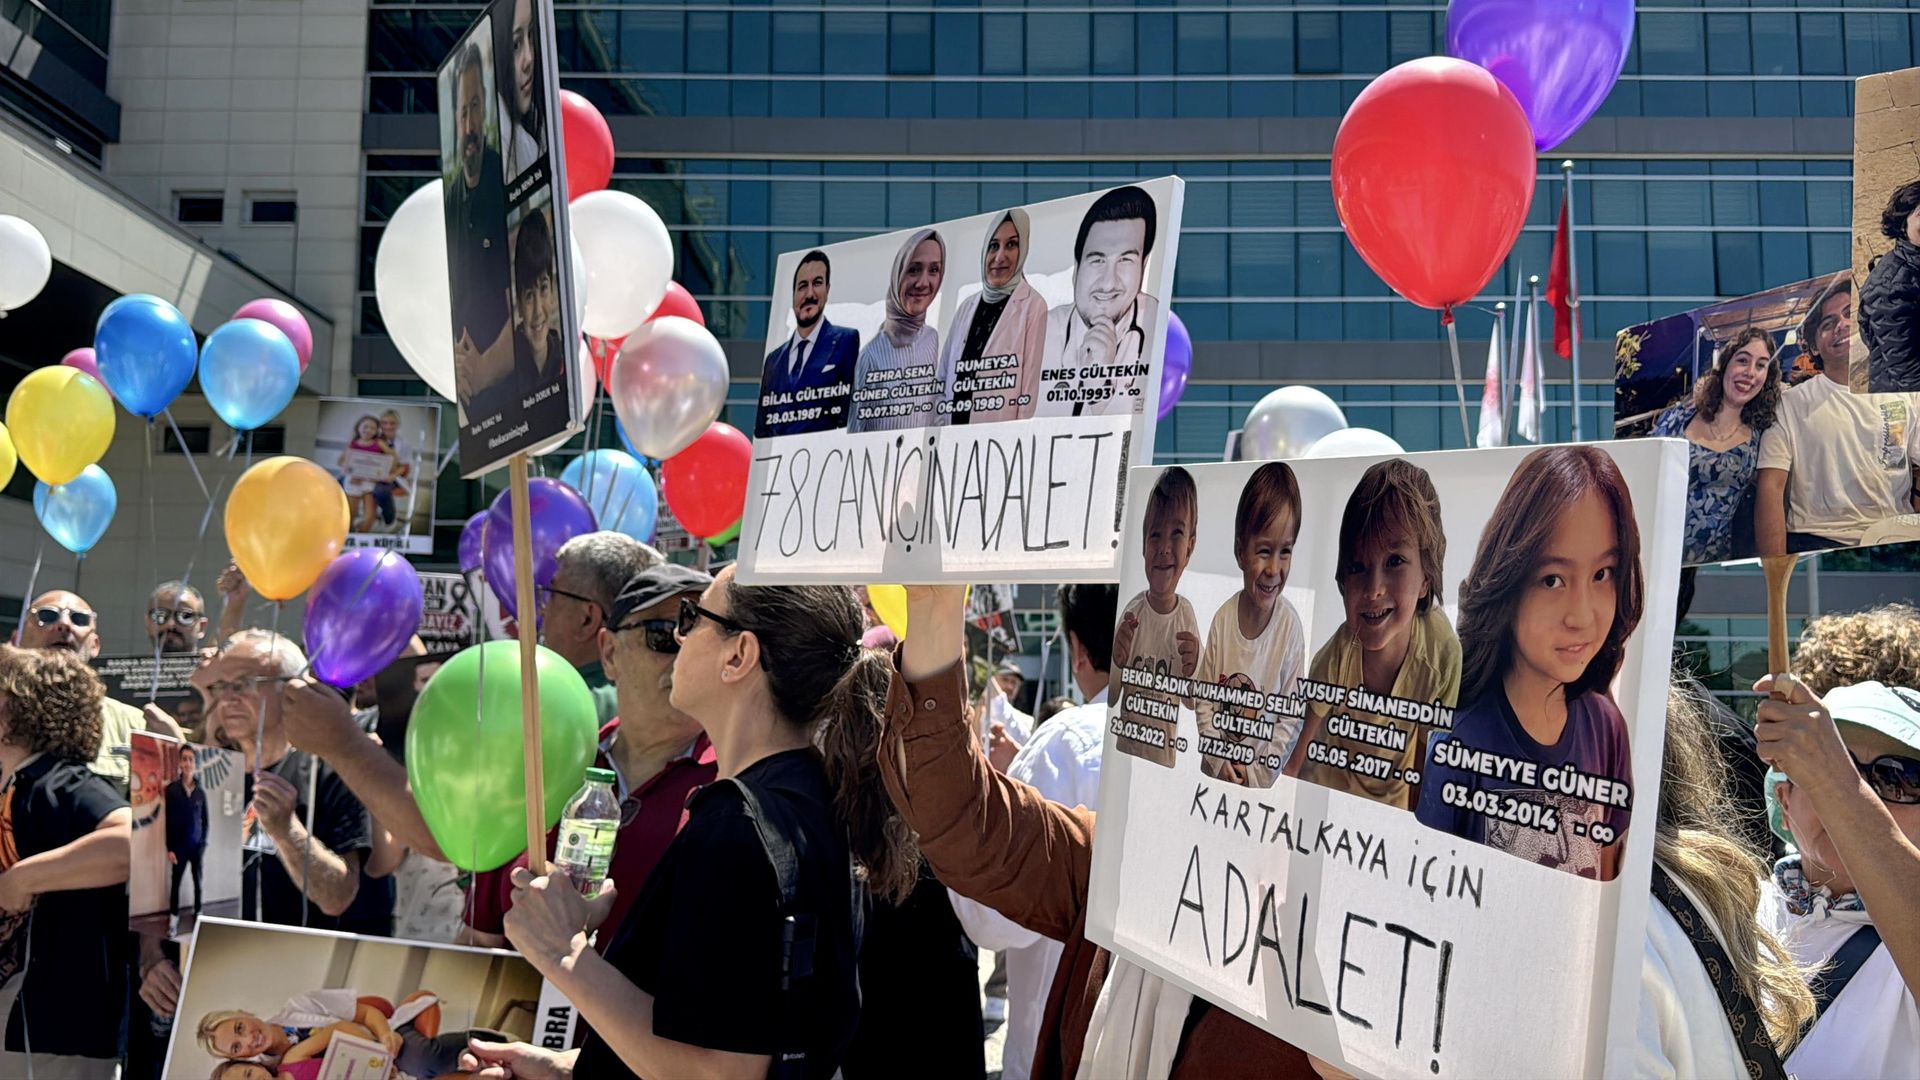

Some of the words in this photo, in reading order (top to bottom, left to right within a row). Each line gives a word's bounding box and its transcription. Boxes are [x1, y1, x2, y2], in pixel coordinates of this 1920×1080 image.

[866, 370, 902, 384] ZEHRA
[904, 366, 934, 379] SENA
[955, 354, 1018, 373] RUMEYSA
[1041, 368, 1076, 381] ENES
[1079, 361, 1149, 380] GÜLTEKİN
[762, 391, 793, 407] BİLAL
[796, 381, 850, 403] GÜLTEKİN
[853, 387, 888, 402] GÜNER
[891, 379, 945, 398] GÜLTEKİN
[953, 371, 1016, 393] GÜLTEKİN
[1047, 388, 1111, 402] 01.10.1993
[766, 407, 822, 425] 28.03.1987
[858, 403, 913, 419] 30.07.1987
[1121, 667, 1153, 688] BEKİR
[1154, 674, 1190, 697] SADIK
[1125, 694, 1178, 721] GÜLTEKİN
[1192, 681, 1264, 708] MUHAMMED
[1265, 694, 1307, 718] SELİM
[1298, 679, 1346, 704] YUSUF
[1348, 686, 1454, 727] SİNANEDDİN
[1111, 718, 1165, 747] 29.03.2022
[1213, 711, 1273, 740] GÜLTEKİN
[1328, 714, 1406, 750] GÜLTEKİN
[1199, 736, 1254, 763] 17.12.2019
[1434, 740, 1537, 785] SÜMEYYE
[1542, 766, 1629, 807] GÜNER
[1442, 783, 1557, 831] 03.03.2014
[1190, 782, 1388, 880] KARTALKAYA
[1407, 839, 1483, 908] İÇİN
[1169, 844, 1454, 1075] ADALET!
